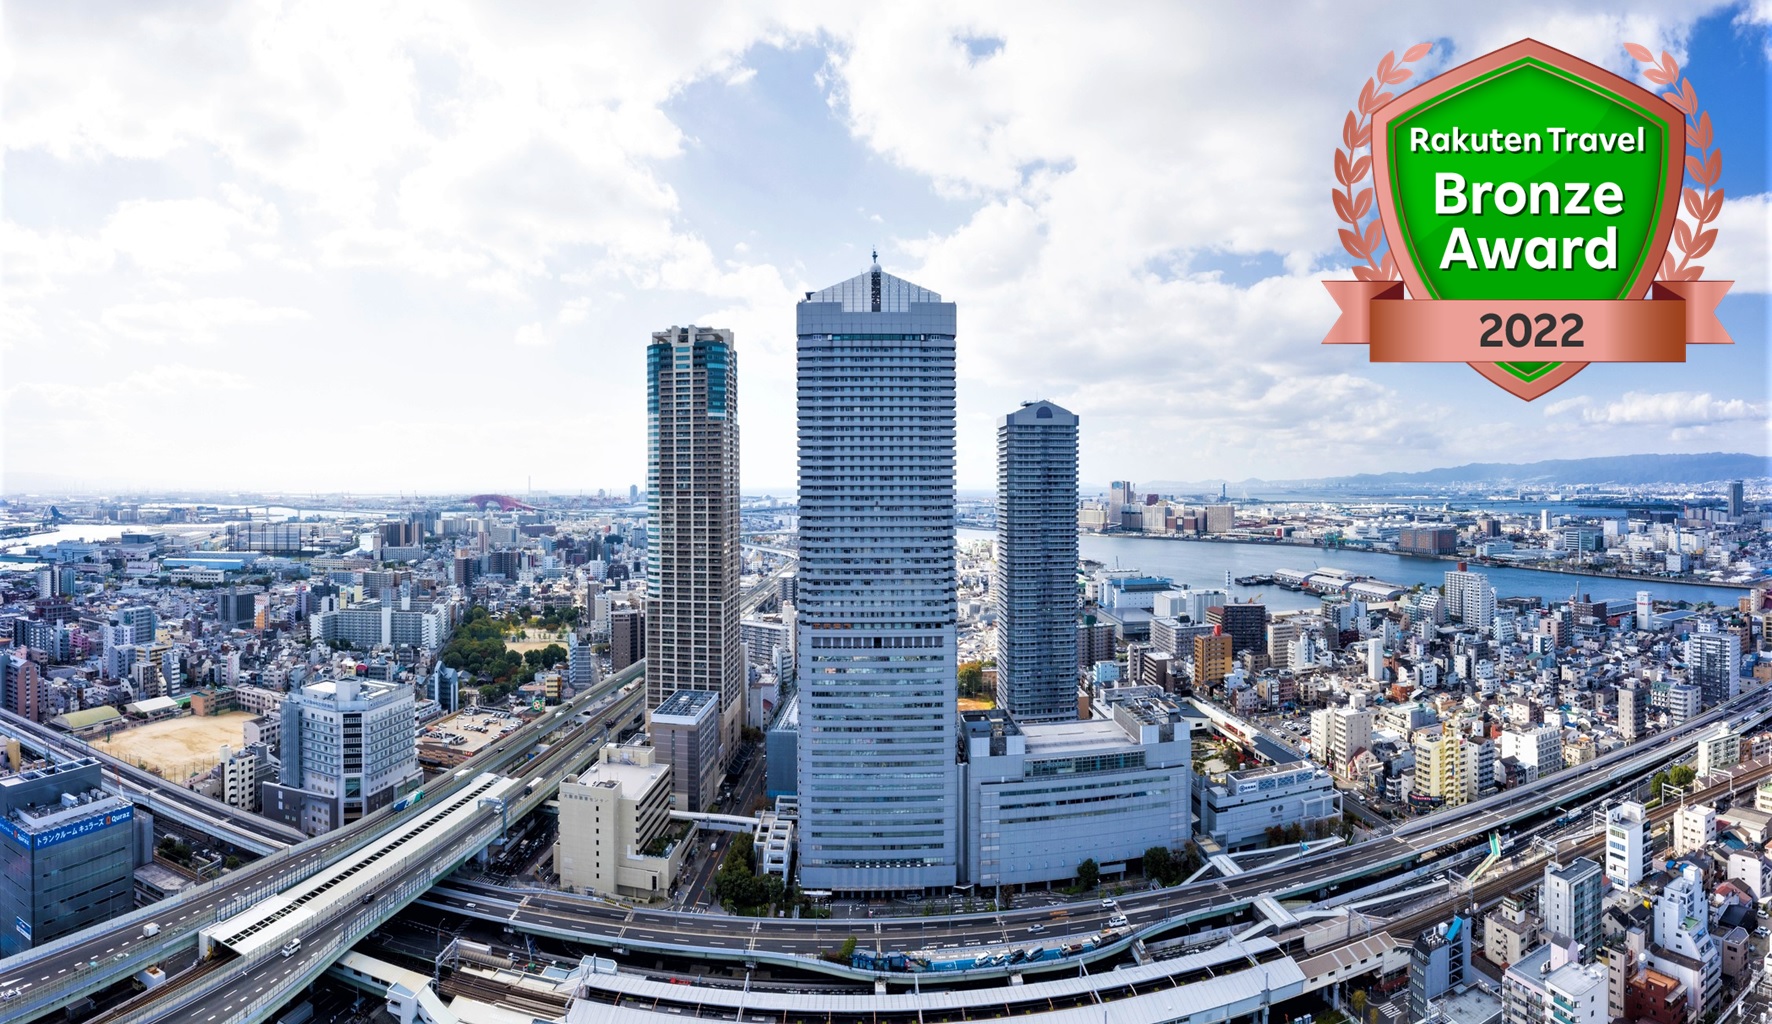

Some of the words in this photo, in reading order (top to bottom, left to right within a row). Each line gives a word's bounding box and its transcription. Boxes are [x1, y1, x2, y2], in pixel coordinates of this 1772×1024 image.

[37, 828, 78, 846] トランクルーム
[79, 818, 104, 832] キュラーズ
[111, 812, 130, 823] Quraz
